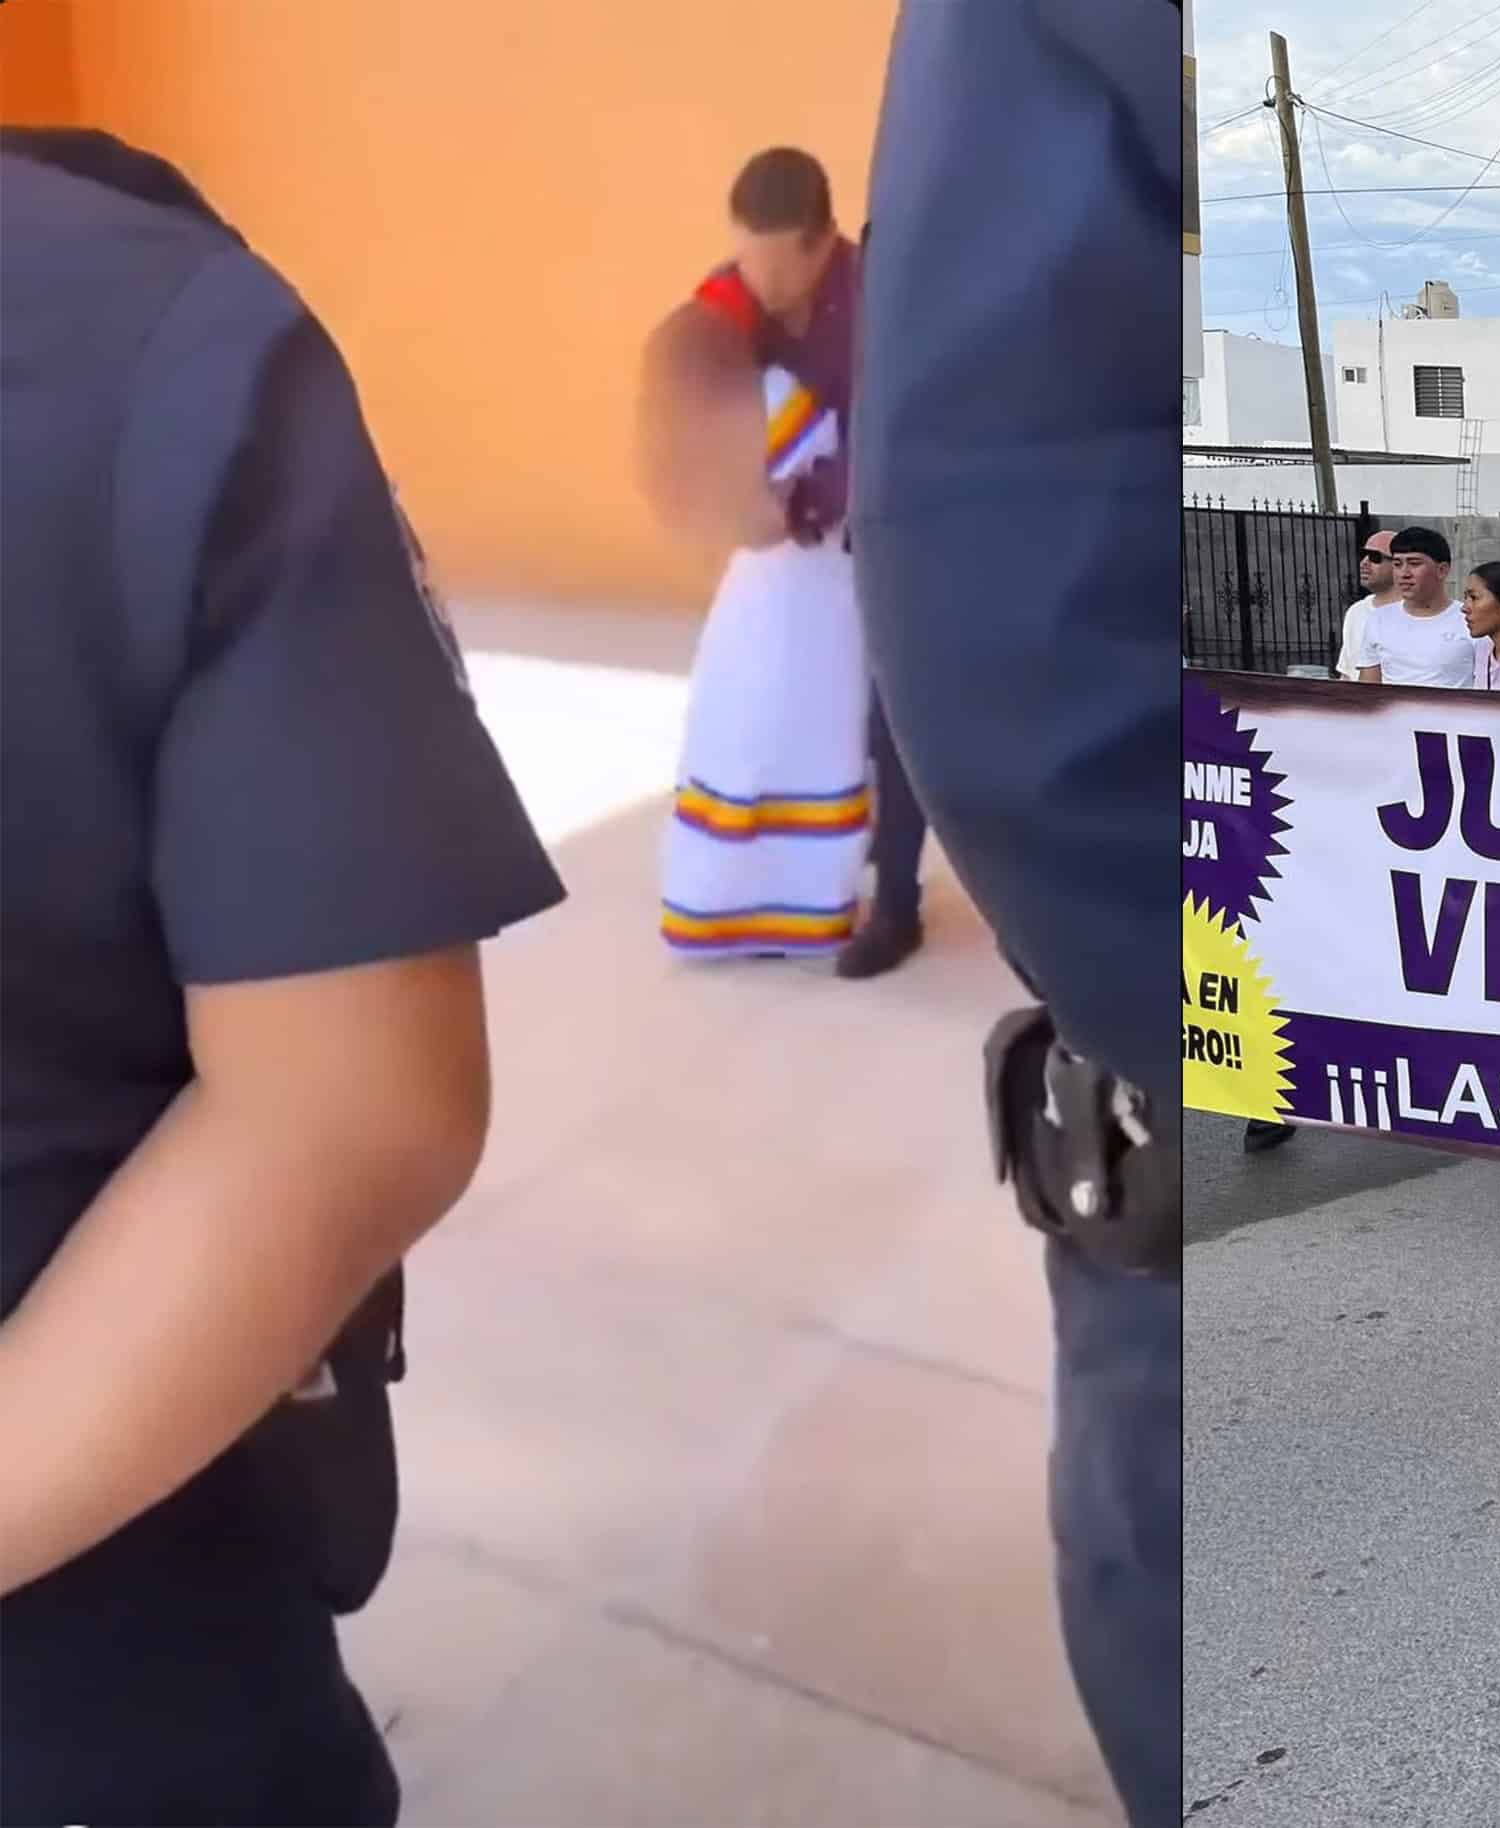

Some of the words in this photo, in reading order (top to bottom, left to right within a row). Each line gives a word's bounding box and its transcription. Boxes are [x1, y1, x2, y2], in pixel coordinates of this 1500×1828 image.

[1183, 761, 1252, 807] NME
[1183, 819, 1218, 861] JA
[1199, 971, 1238, 1014] EN
